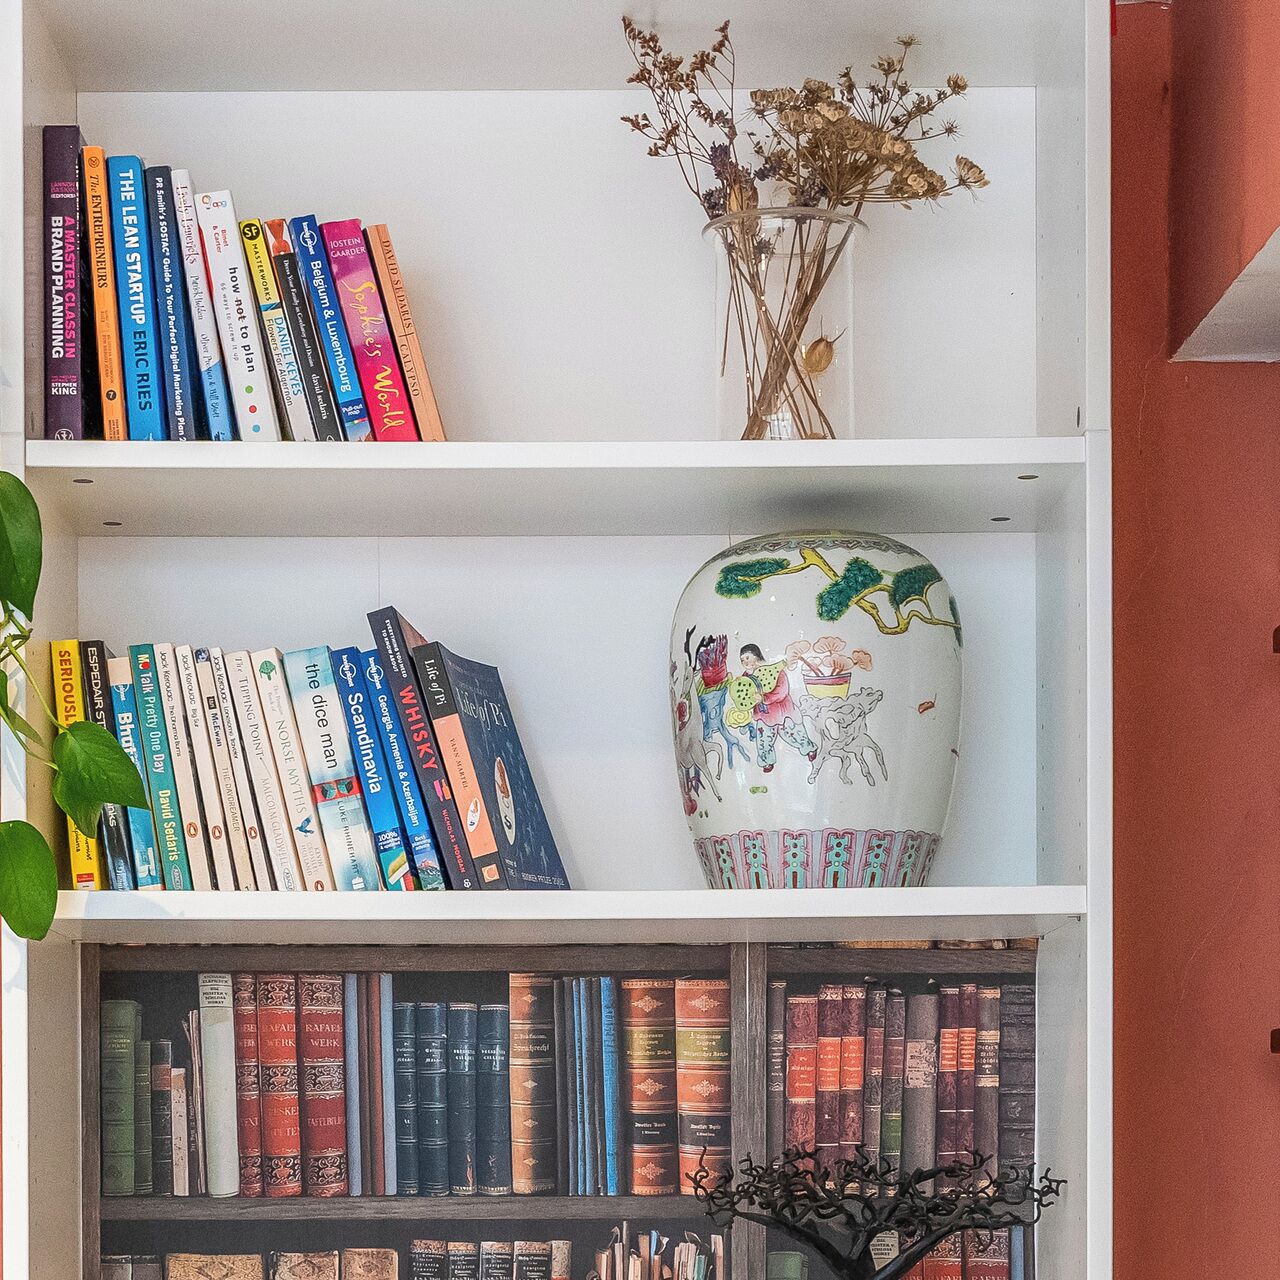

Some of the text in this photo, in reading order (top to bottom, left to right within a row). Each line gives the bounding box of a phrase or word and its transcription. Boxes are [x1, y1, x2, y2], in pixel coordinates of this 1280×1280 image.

[89, 175, 107, 289] The ENTREPRENEURS
[212, 232, 222, 254] Carter
[220, 229, 229, 247] Binet
[244, 226, 258, 237] SF
[300, 221, 316, 255] lonely planet
[329, 238, 361, 248] JOSTEIN
[330, 247, 366, 258] GAARDER
[51, 217, 63, 358] BRAND PLANNING
[65, 216, 76, 358] A MASTER CLASS IN
[119, 169, 152, 411] THE LEAN STARTUP ERIC RIES
[251, 242, 272, 301] MASTERWORKS
[382, 240, 413, 329] DAVID SEDARIS
[155, 177, 185, 435] PR Guide To Your Perfect Digital Marketing Plan
[220, 293, 229, 310] ways
[225, 312, 231, 320] to
[228, 266, 256, 373] how not to plan
[286, 274, 310, 348] Your Family and
[308, 259, 354, 392] Belgium & Luxembourg
[226, 322, 235, 342] screw
[231, 352, 238, 362] up
[273, 315, 302, 396] DANIEL KEYES
[341, 280, 405, 433] Sophie's World
[264, 318, 294, 406] Flowers For Algernon
[400, 343, 421, 397] CALYPSO
[310, 373, 330, 420] david sedaris
[158, 650, 174, 701] Jack Kerouac
[339, 654, 355, 687] lonely planet
[367, 656, 382, 689] lonely planet
[383, 636, 392, 653] KNOW
[388, 653, 398, 672] ABOUT
[384, 619, 408, 678] EVERYTHING YOU NEED
[58, 649, 77, 727] SERIOUSL
[87, 646, 103, 708] ESPEDAIR
[180, 652, 197, 704] Jack Kerouac
[212, 654, 229, 703] Jack Kerouac
[423, 658, 446, 706] Life of Pi
[139, 672, 166, 774] Talk Pretty One Day
[170, 715, 179, 740] Dharma
[190, 708, 198, 718] Big
[210, 711, 224, 747] McEwan
[223, 706, 234, 736] Lonesome
[234, 656, 265, 757] The TIPPING POINT
[303, 662, 338, 769] the dice man
[397, 684, 438, 773] WHISKY
[479, 699, 508, 731] of Pi
[174, 740, 182, 756] Bums
[275, 719, 307, 814] NORSE MYTHS
[345, 691, 385, 794] Scandinavia
[376, 694, 420, 827] Georgia, Armenia & Azerbaijan
[449, 738, 469, 789] YANN MARTEL
[158, 788, 180, 861] David Sedaris
[221, 766, 240, 832] THE DAYDREAMER
[260, 776, 288, 866] MALCOLM GLADWELL
[336, 800, 360, 875] LUKE RHINEHART
[378, 831, 397, 841] 100%
[440, 809, 466, 873] NICHOLAS MORGAN
[310, 1038, 340, 1047] WERK
